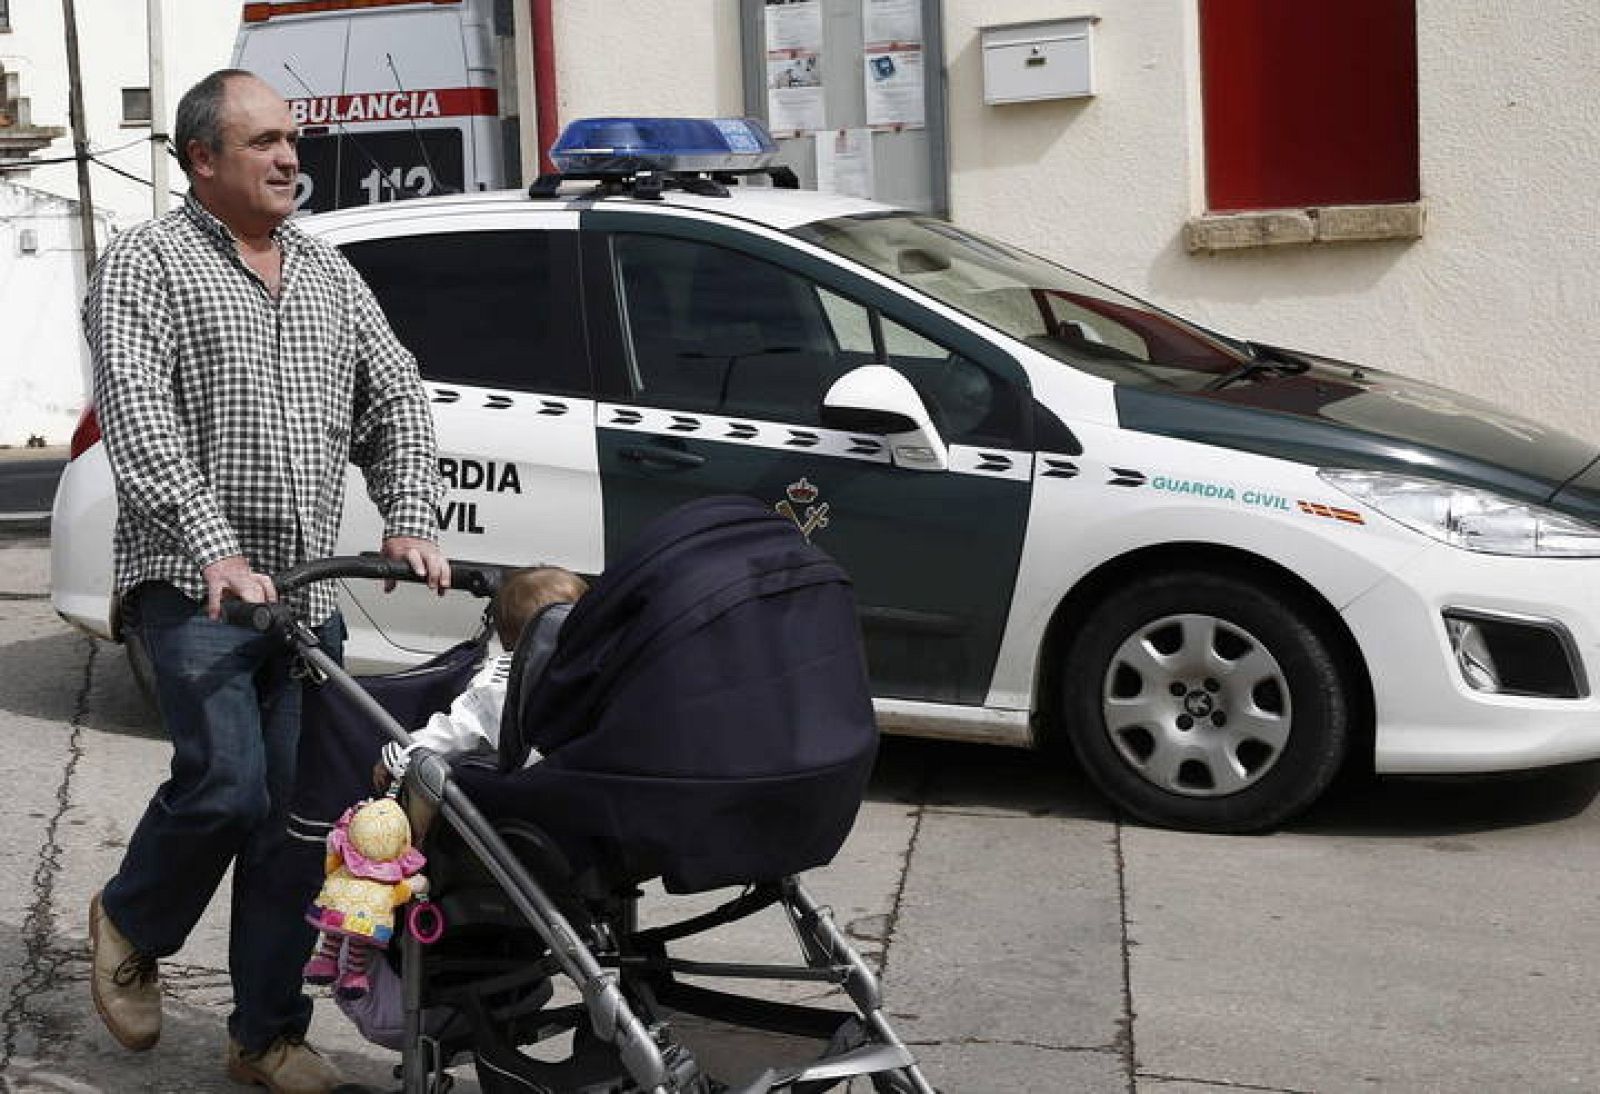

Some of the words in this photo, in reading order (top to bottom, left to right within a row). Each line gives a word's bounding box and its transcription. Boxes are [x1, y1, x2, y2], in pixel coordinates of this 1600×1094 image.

[291, 90, 440, 123] BULANCIA
[360, 166, 433, 204] 112
[438, 457, 521, 494] RDIA
[1152, 477, 1236, 500] GUARDIA
[1241, 491, 1290, 510] CIVIL
[435, 502, 484, 534] VIL
